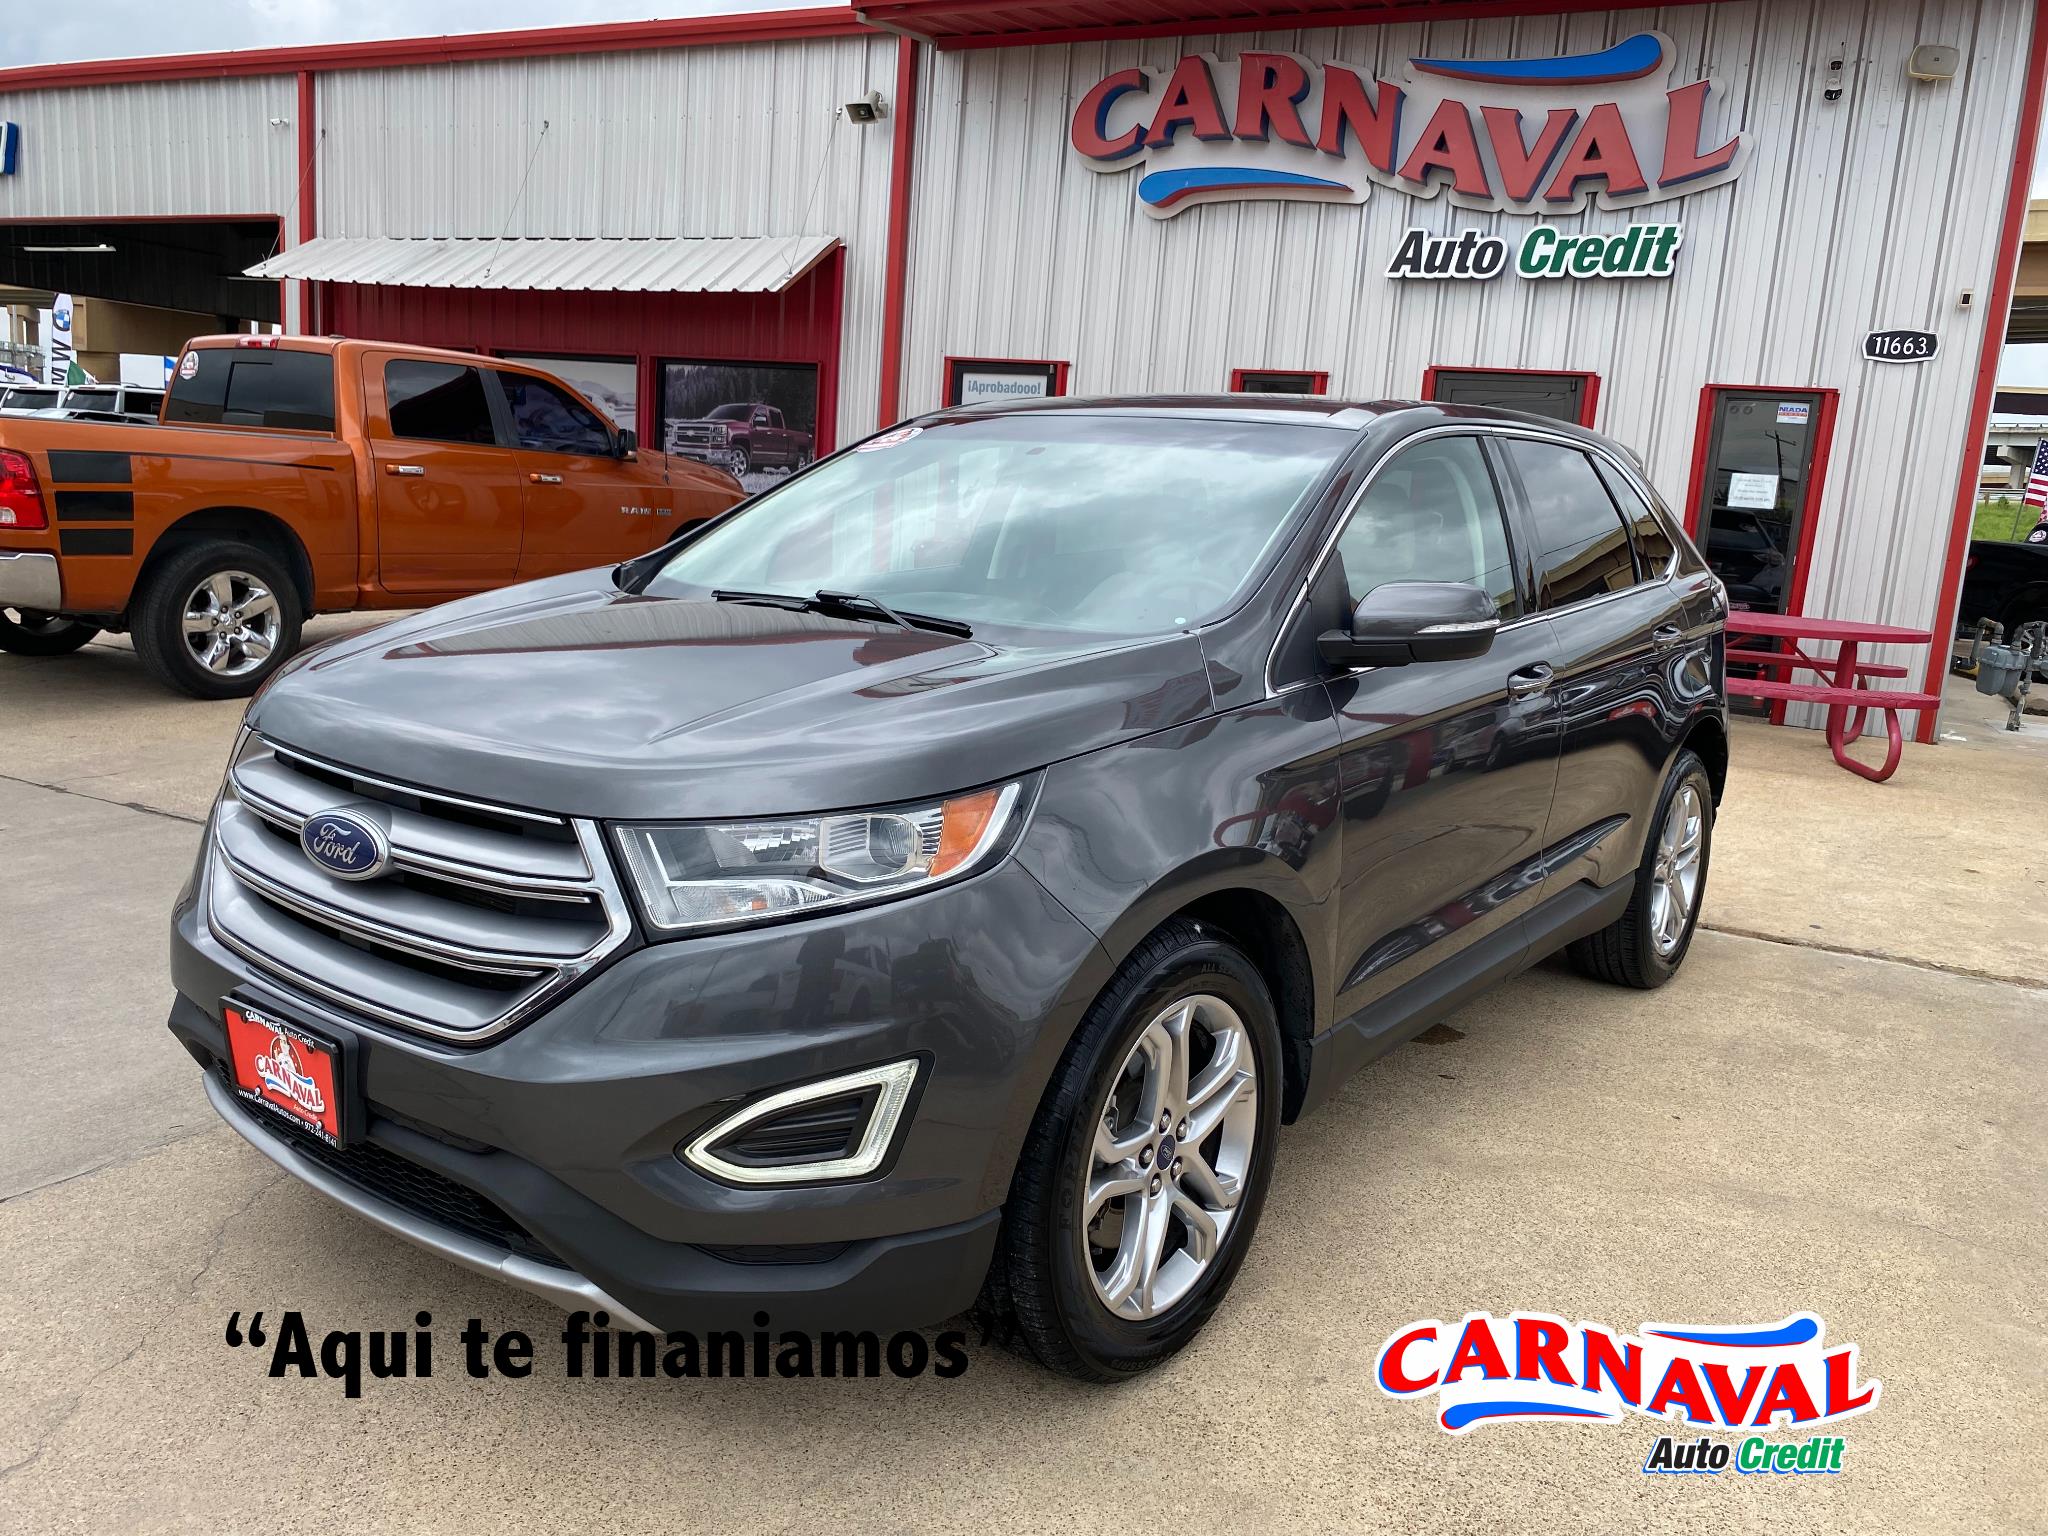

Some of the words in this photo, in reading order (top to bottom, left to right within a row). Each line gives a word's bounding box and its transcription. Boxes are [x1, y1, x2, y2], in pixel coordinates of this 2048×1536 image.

[1071, 52, 1740, 201] CARNAVAL
[1388, 229, 1504, 276] Auto
[1518, 226, 1680, 275] Credit
[1873, 336, 1928, 355] 11663
[313, 822, 361, 865] Ford
[245, 1010, 284, 1035] CARNAVAL
[256, 1055, 324, 1109] CARNAVAL
